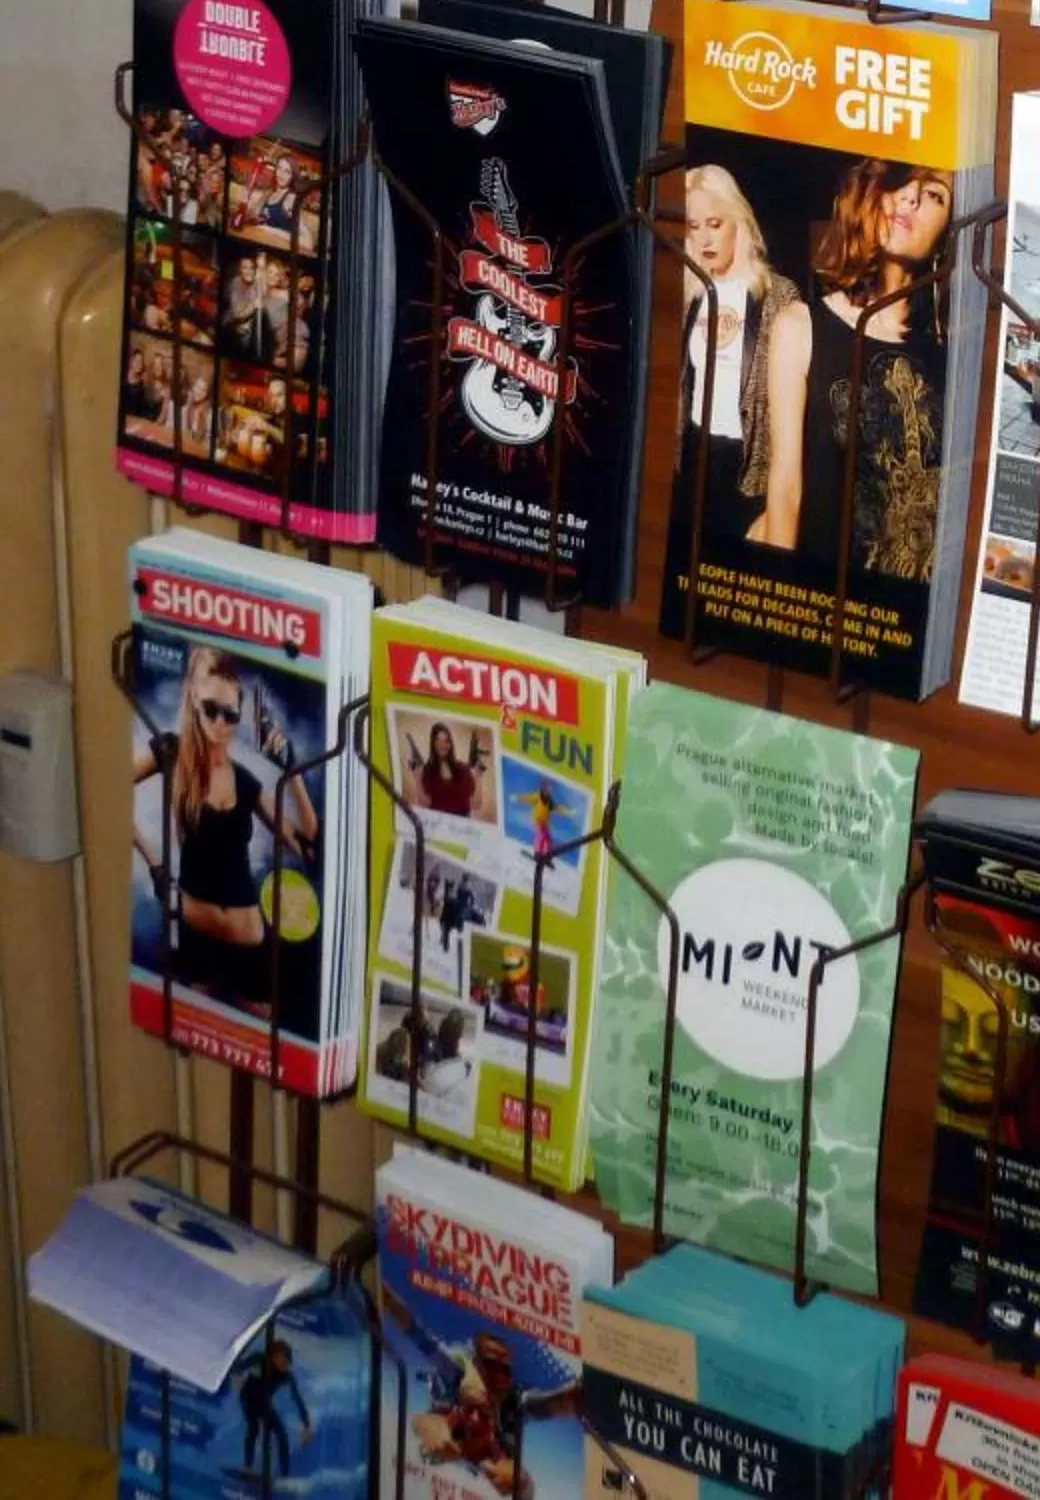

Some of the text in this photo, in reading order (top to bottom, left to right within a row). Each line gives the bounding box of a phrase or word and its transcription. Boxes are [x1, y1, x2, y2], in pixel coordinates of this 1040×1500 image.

[205, 0, 261, 33] DOUBLE
[704, 40, 817, 90] Hard Rock
[747, 81, 777, 97] CAFE
[835, 45, 931, 98] FREE
[836, 90, 928, 140] GIFT
[499, 233, 529, 267] THE
[477, 260, 549, 320] COOLEST
[457, 325, 491, 357] HELL
[493, 342, 515, 369] ON
[462, 486, 589, 531] Cocktail & Bar
[152, 579, 306, 647] SHOOTING
[705, 601, 729, 621] PUT
[732, 607, 752, 626] ON
[753, 612, 764, 629] A
[766, 616, 799, 638] PIECE
[802, 626, 818, 642] OF
[735, 590, 913, 647] FOR DECADES. IN AND
[738, 572, 900, 624] HAVE BEEN ROCING OUR
[410, 651, 557, 717] ACTION
[521, 719, 594, 775] FUN
[676, 743, 876, 804] Prague alternative market
[701, 772, 751, 797] selling
[755, 785, 813, 808] original
[747, 802, 798, 827] design
[802, 816, 831, 834] and
[755, 822, 796, 846] Made
[741, 996, 798, 1023] MARKET
[648, 1069, 793, 1134] Eery Saturday
[386, 1194, 571, 1294] SKYDIVING
[429, 1247, 573, 1329] PRAGUE
[619, 1387, 779, 1465] ALL THE CHOCOLATE
[623, 1412, 778, 1494] YOU CAN EAT
